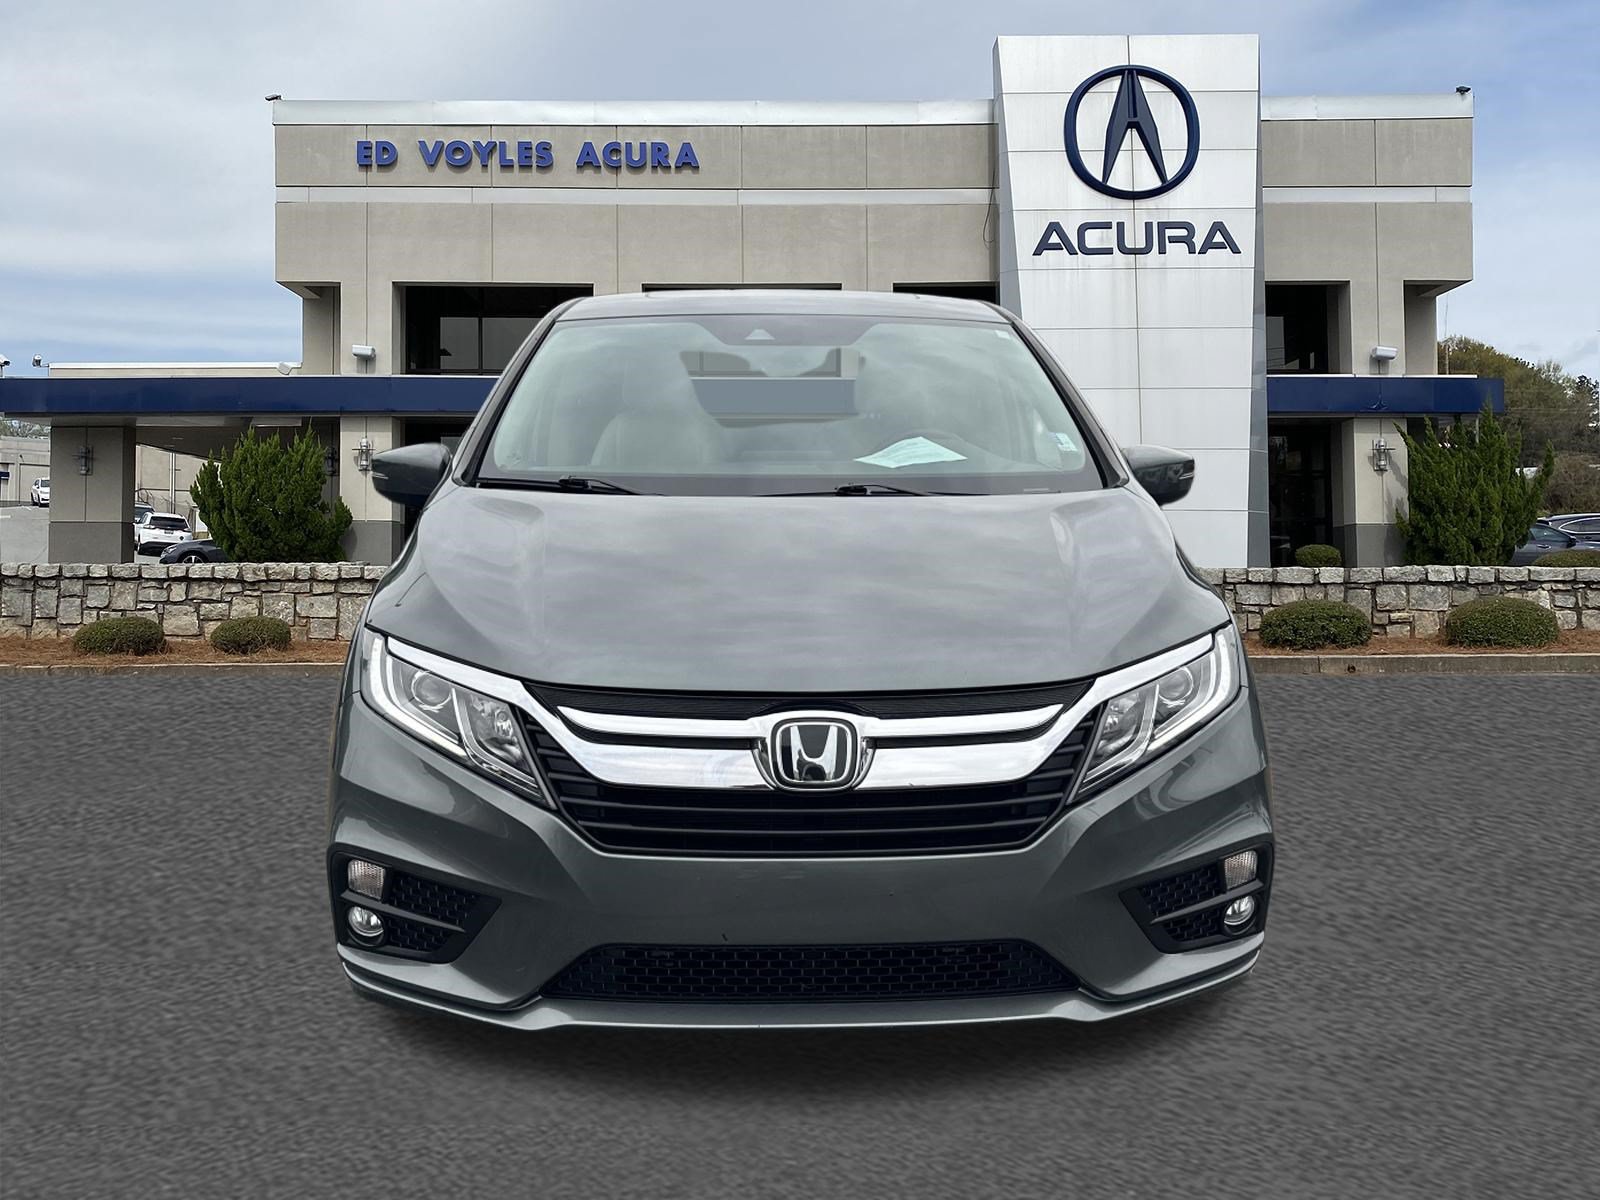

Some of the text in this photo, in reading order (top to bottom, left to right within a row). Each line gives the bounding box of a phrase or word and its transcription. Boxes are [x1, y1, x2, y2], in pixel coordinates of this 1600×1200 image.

[356, 140, 700, 169] ED VOYLES ACURA
[1032, 221, 1242, 256] ACURA
